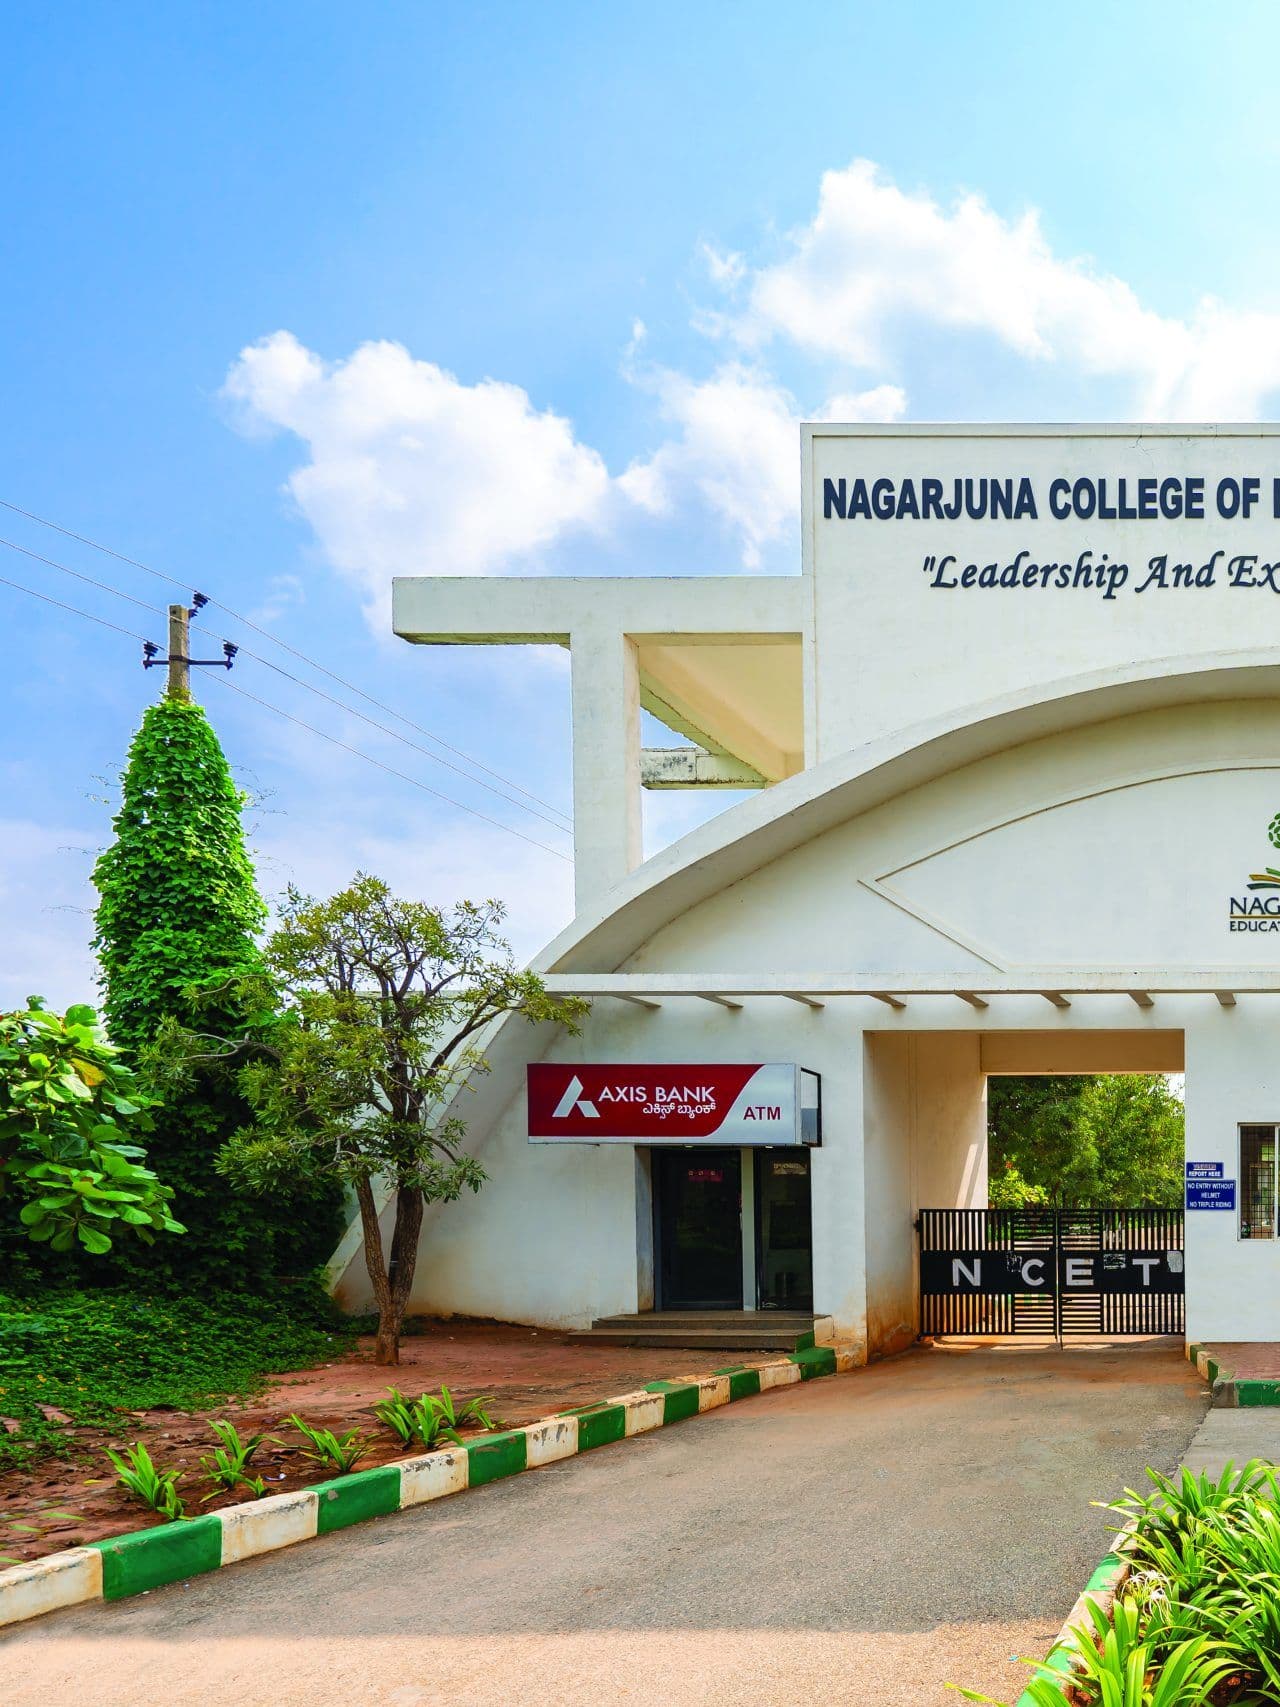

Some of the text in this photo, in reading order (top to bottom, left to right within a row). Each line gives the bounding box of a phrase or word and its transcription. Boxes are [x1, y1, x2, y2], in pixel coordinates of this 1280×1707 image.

[824, 477, 1039, 520] NAGARJUNA
[1048, 477, 1205, 520] COLLEGE
[1216, 477, 1261, 519] OF
[922, 550, 1129, 600] "Leadership
[1134, 550, 1225, 593] And
[598, 1086, 716, 1102] AXIS BANK
[743, 1106, 781, 1121] ATM
